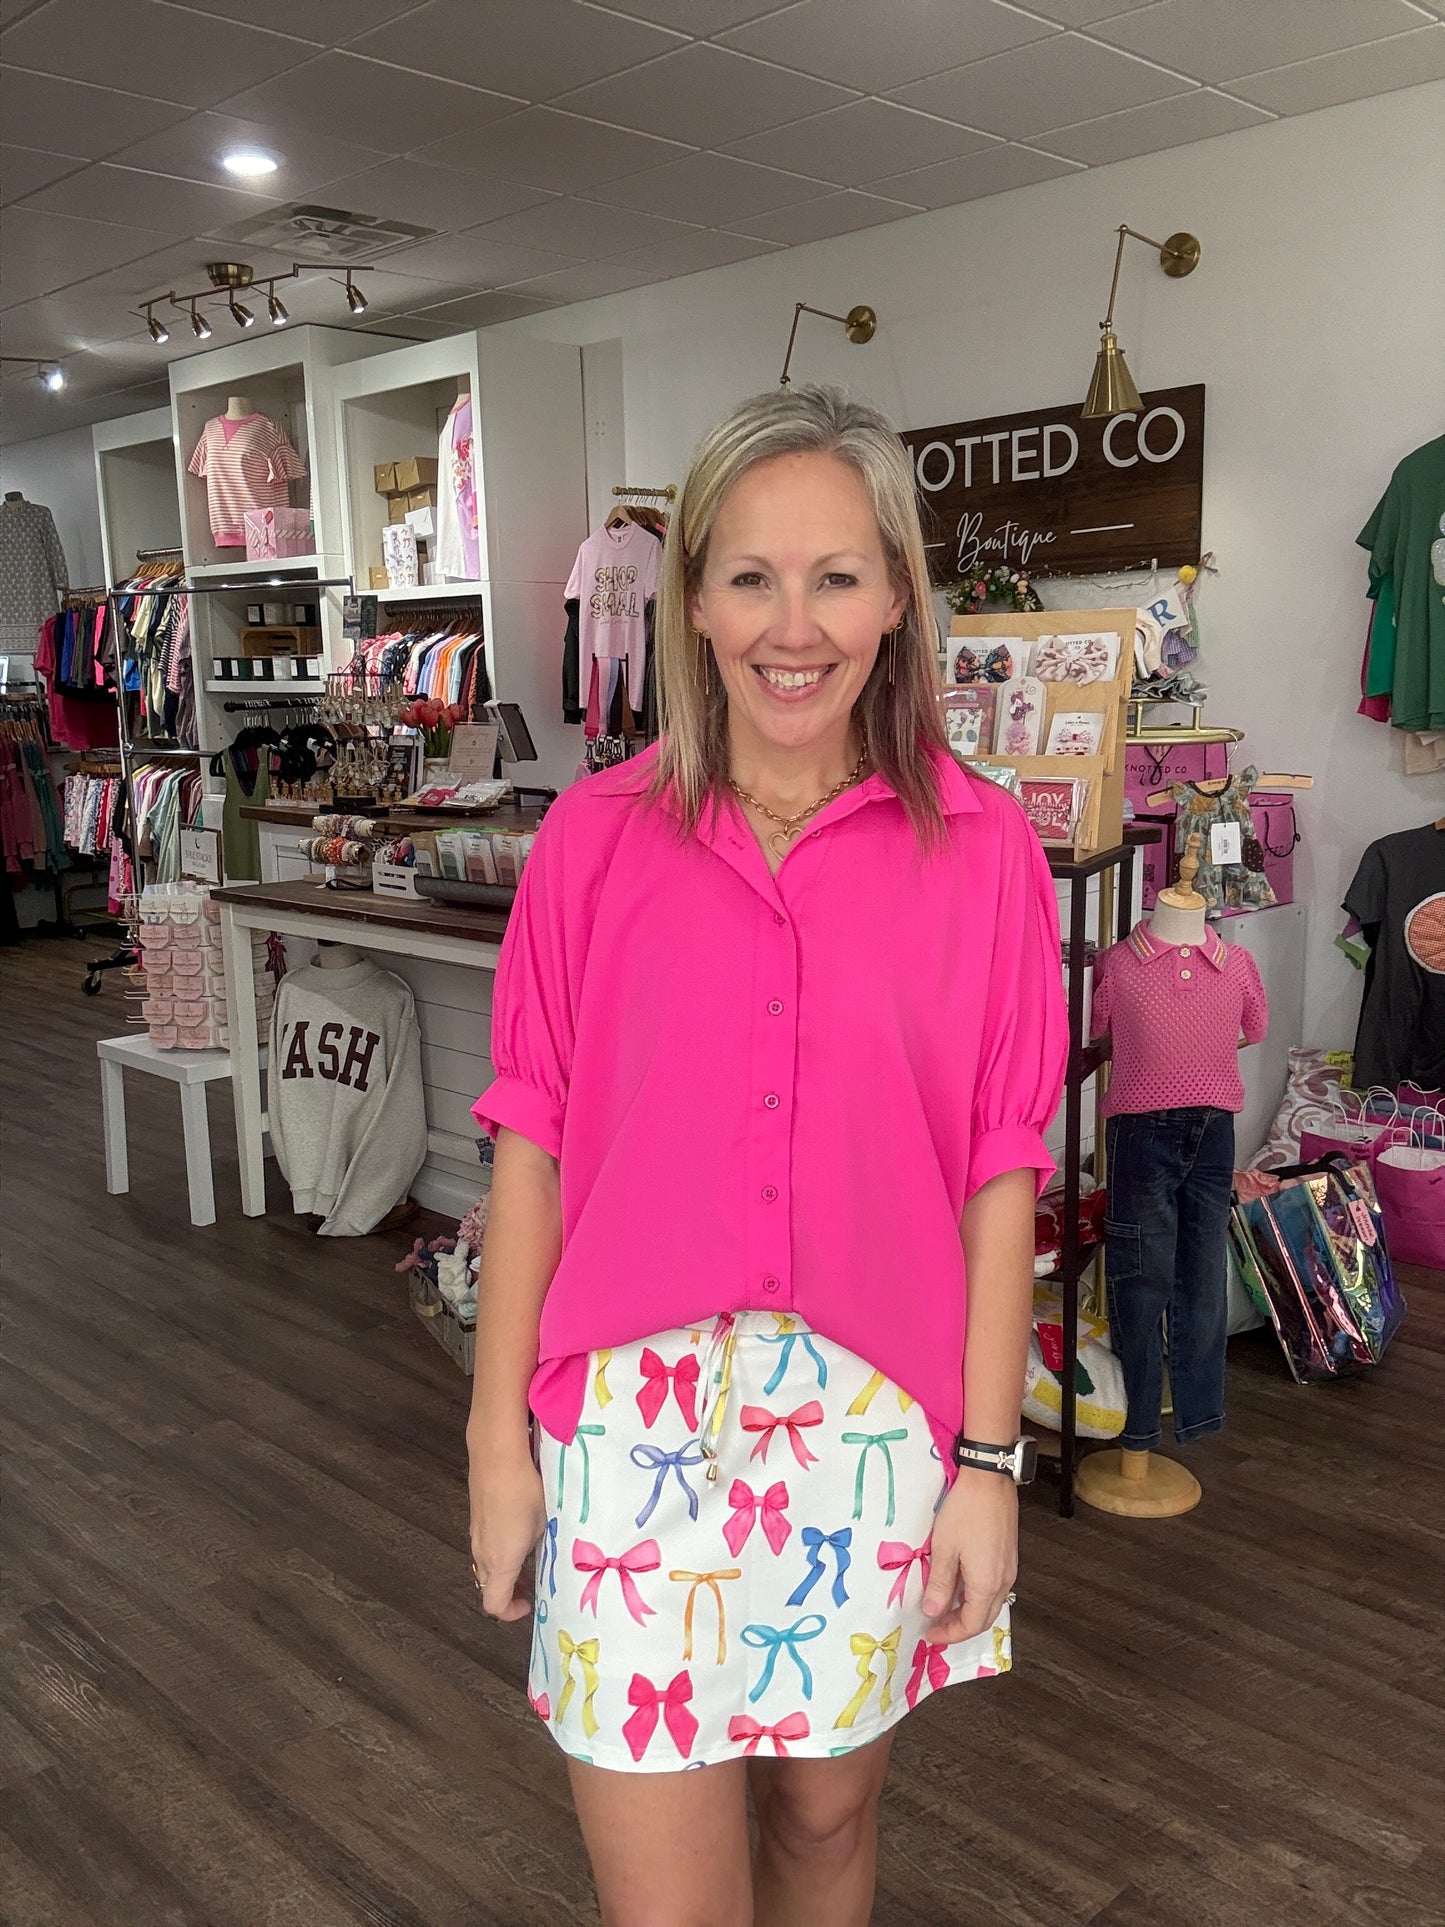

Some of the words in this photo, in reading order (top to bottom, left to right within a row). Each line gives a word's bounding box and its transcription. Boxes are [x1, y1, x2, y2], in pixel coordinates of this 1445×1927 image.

[907, 423, 1079, 492] OTTED
[1102, 406, 1186, 468] CO
[956, 512, 1057, 574] Boutique
[595, 566, 638, 592] SHOP
[590, 592, 639, 619] SMALL
[1146, 599, 1177, 627] R
[1175, 765, 1187, 774] CO
[1031, 792, 1065, 808] JOY
